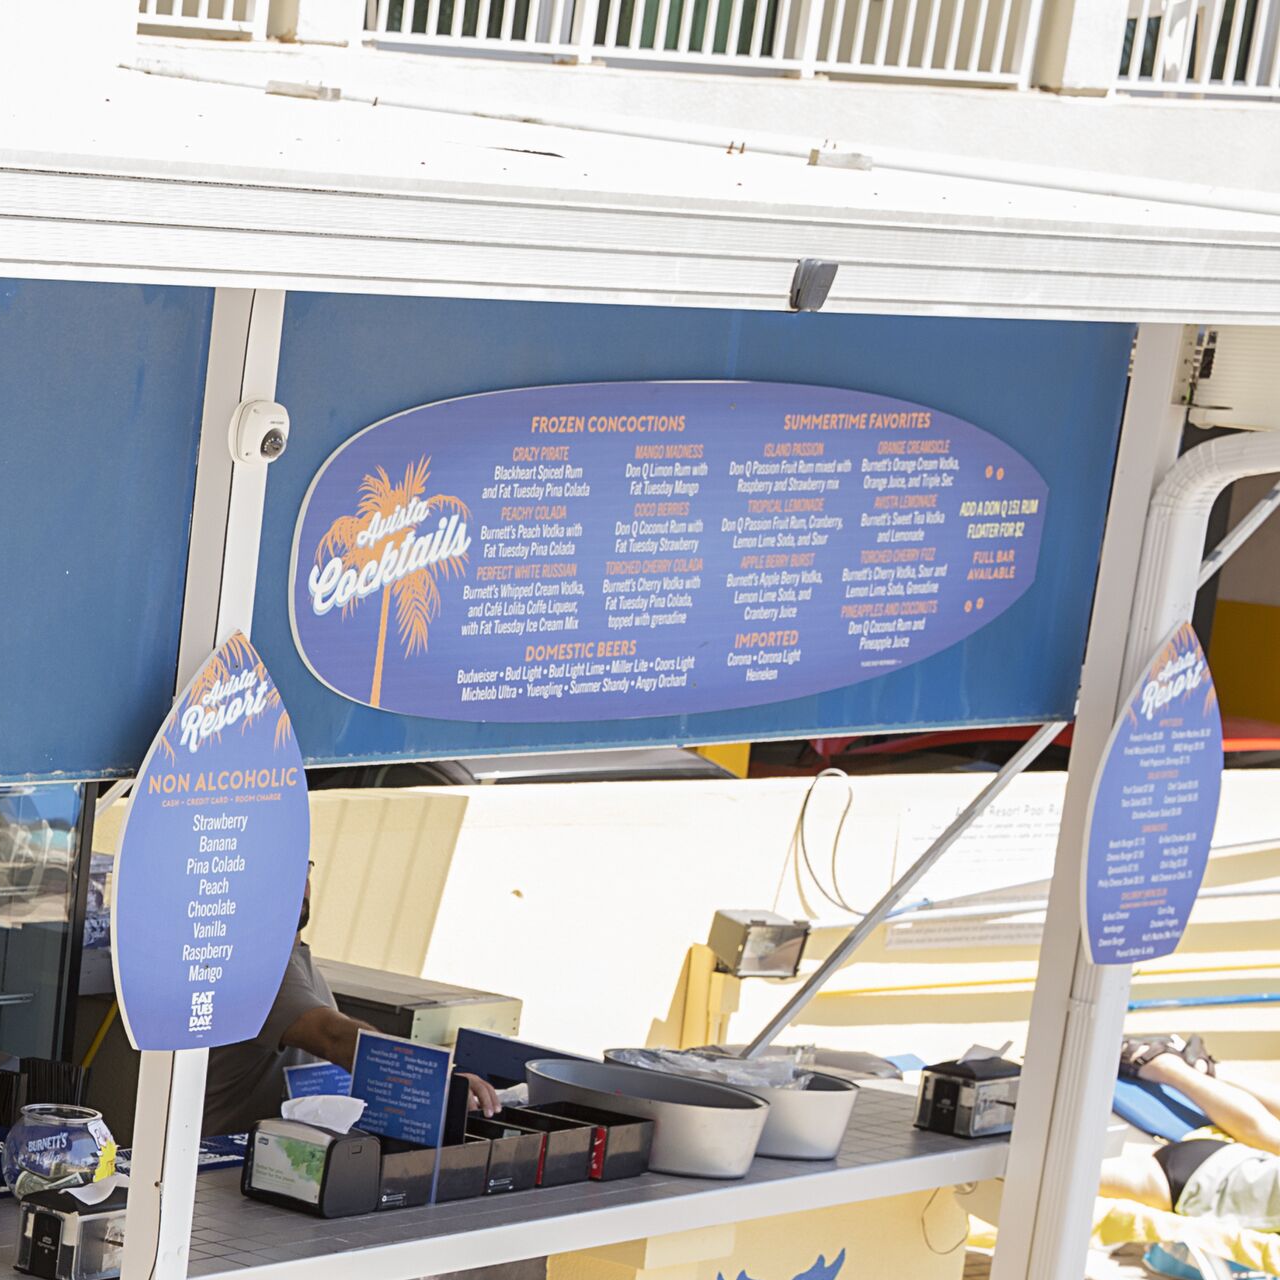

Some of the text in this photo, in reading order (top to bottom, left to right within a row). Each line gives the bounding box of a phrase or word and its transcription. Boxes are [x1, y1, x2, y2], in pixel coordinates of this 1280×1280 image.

[531, 415, 686, 434] FROZEN CONCOCTIONS
[783, 411, 931, 431] SUMMERTIME FAVORITES
[493, 463, 583, 482] Blackheart Spiced Rum
[356, 496, 429, 548] Avista
[309, 514, 471, 616] Cocktails
[972, 549, 1015, 565] FULL BAR
[966, 565, 1016, 581] AVAILABLE
[734, 629, 799, 649] IMPORTED
[524, 639, 637, 663] DOMESTIC BEERS
[745, 667, 779, 682] Heineken
[203, 668, 257, 705] Avista
[1140, 660, 1203, 721] Resort
[180, 680, 268, 753] Resort
[148, 767, 299, 795] NON ALCOHOLIC
[161, 799, 180, 808] CASH
[186, 798, 209, 806] CREDIT
[192, 812, 249, 832] Strawberry
[199, 835, 238, 853] Banana
[186, 854, 246, 875] Pina Colada
[198, 876, 229, 896] Peach
[187, 898, 237, 919] Chocolate
[193, 919, 227, 939] Vanilla
[182, 942, 234, 963] Raspberry
[188, 964, 223, 984] Mango
[191, 990, 215, 1005] FAT
[190, 1003, 214, 1017] TUES
[189, 1014, 212, 1028] DAY
